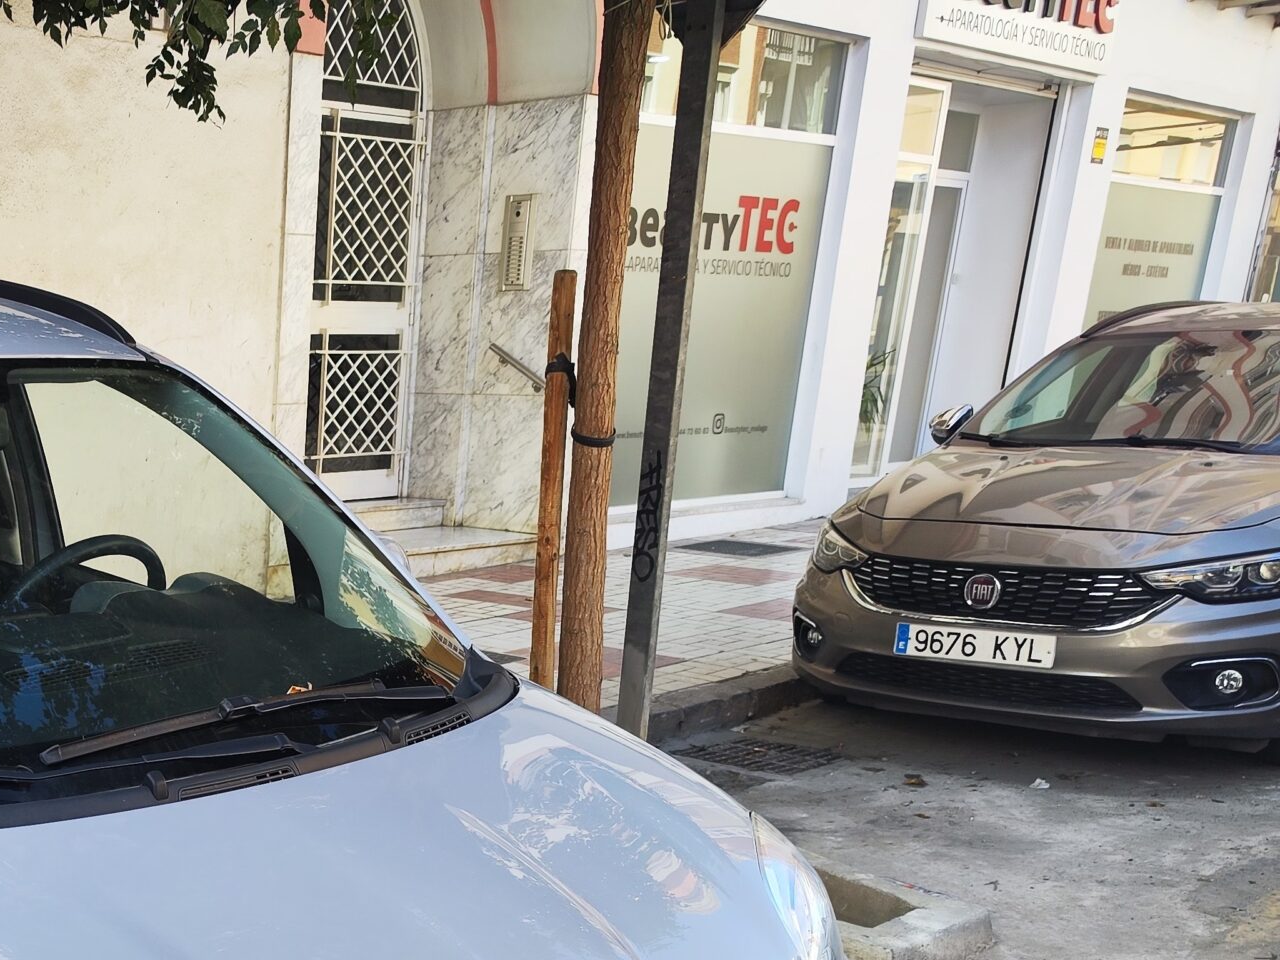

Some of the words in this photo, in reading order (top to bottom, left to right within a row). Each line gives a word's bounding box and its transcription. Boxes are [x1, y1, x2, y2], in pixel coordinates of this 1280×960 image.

[947, 8, 1018, 41] APARATOLOGÍA
[1021, 25, 1029, 43] Y
[1029, 26, 1068, 54] SERVICIO
[1071, 34, 1106, 62] TÉCNICO
[1104, 236, 1122, 249] VENTA
[1151, 240, 1159, 252] DE
[703, 259, 711, 274] Y
[710, 258, 752, 276] SERVICIO
[754, 258, 792, 277] TÉCNICO
[972, 583, 994, 600] FIAT
[898, 641, 905, 649] E
[914, 629, 977, 657] 9676
[992, 635, 1042, 663] KYL
